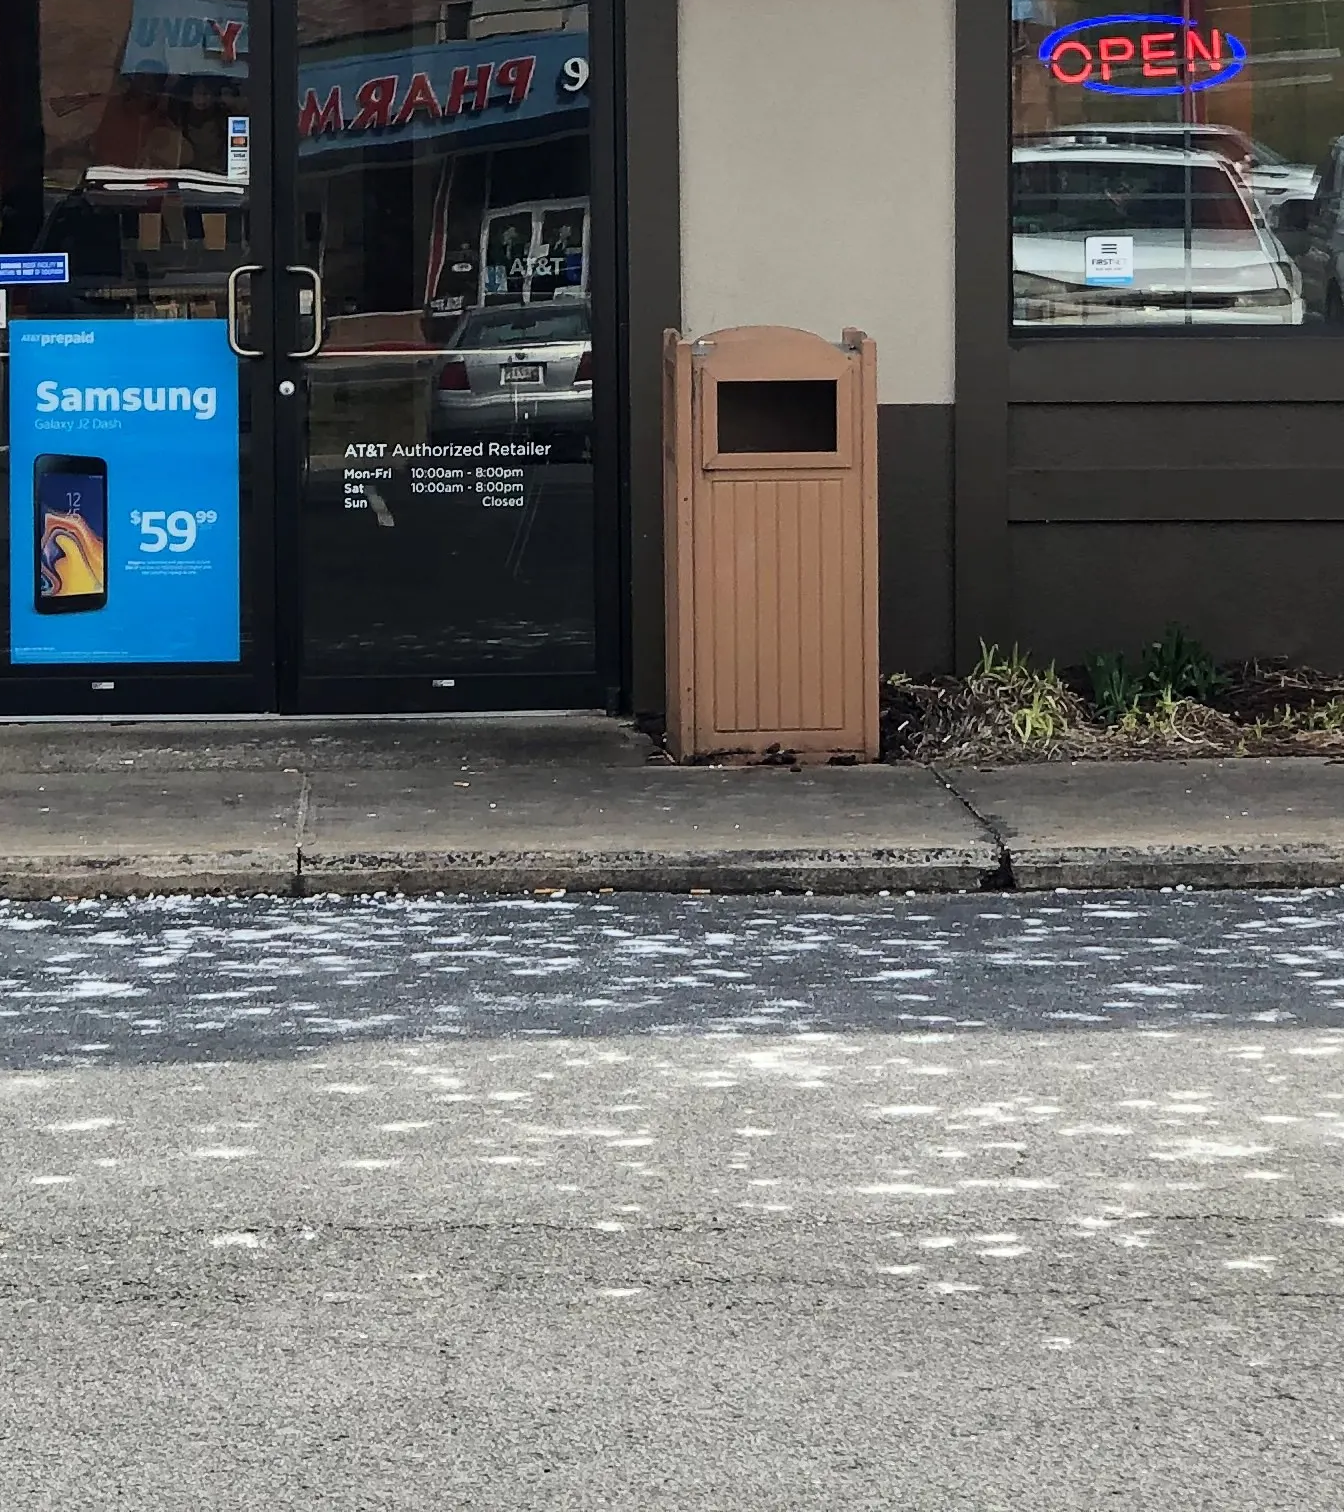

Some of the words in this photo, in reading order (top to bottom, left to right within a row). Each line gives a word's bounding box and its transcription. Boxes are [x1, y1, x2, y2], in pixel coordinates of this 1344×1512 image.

[1052, 28, 1221, 84] OPEN
[40, 331, 95, 347] prepaid
[36, 380, 217, 420] Samsung
[34, 418, 74, 431] Galaxy
[344, 443, 387, 458] AT&T
[391, 442, 484, 457] Authorized
[488, 441, 552, 456] Retailer
[344, 467, 392, 479] Mon-Fri
[410, 467, 464, 479] 10:00am
[475, 467, 524, 480] 8:00pm
[344, 483, 364, 494] Sat
[410, 482, 464, 493] 10:00am
[475, 482, 524, 494] 8:00pm
[66, 492, 81, 507] 12
[344, 497, 368, 509] Sun
[482, 496, 524, 507] Closed
